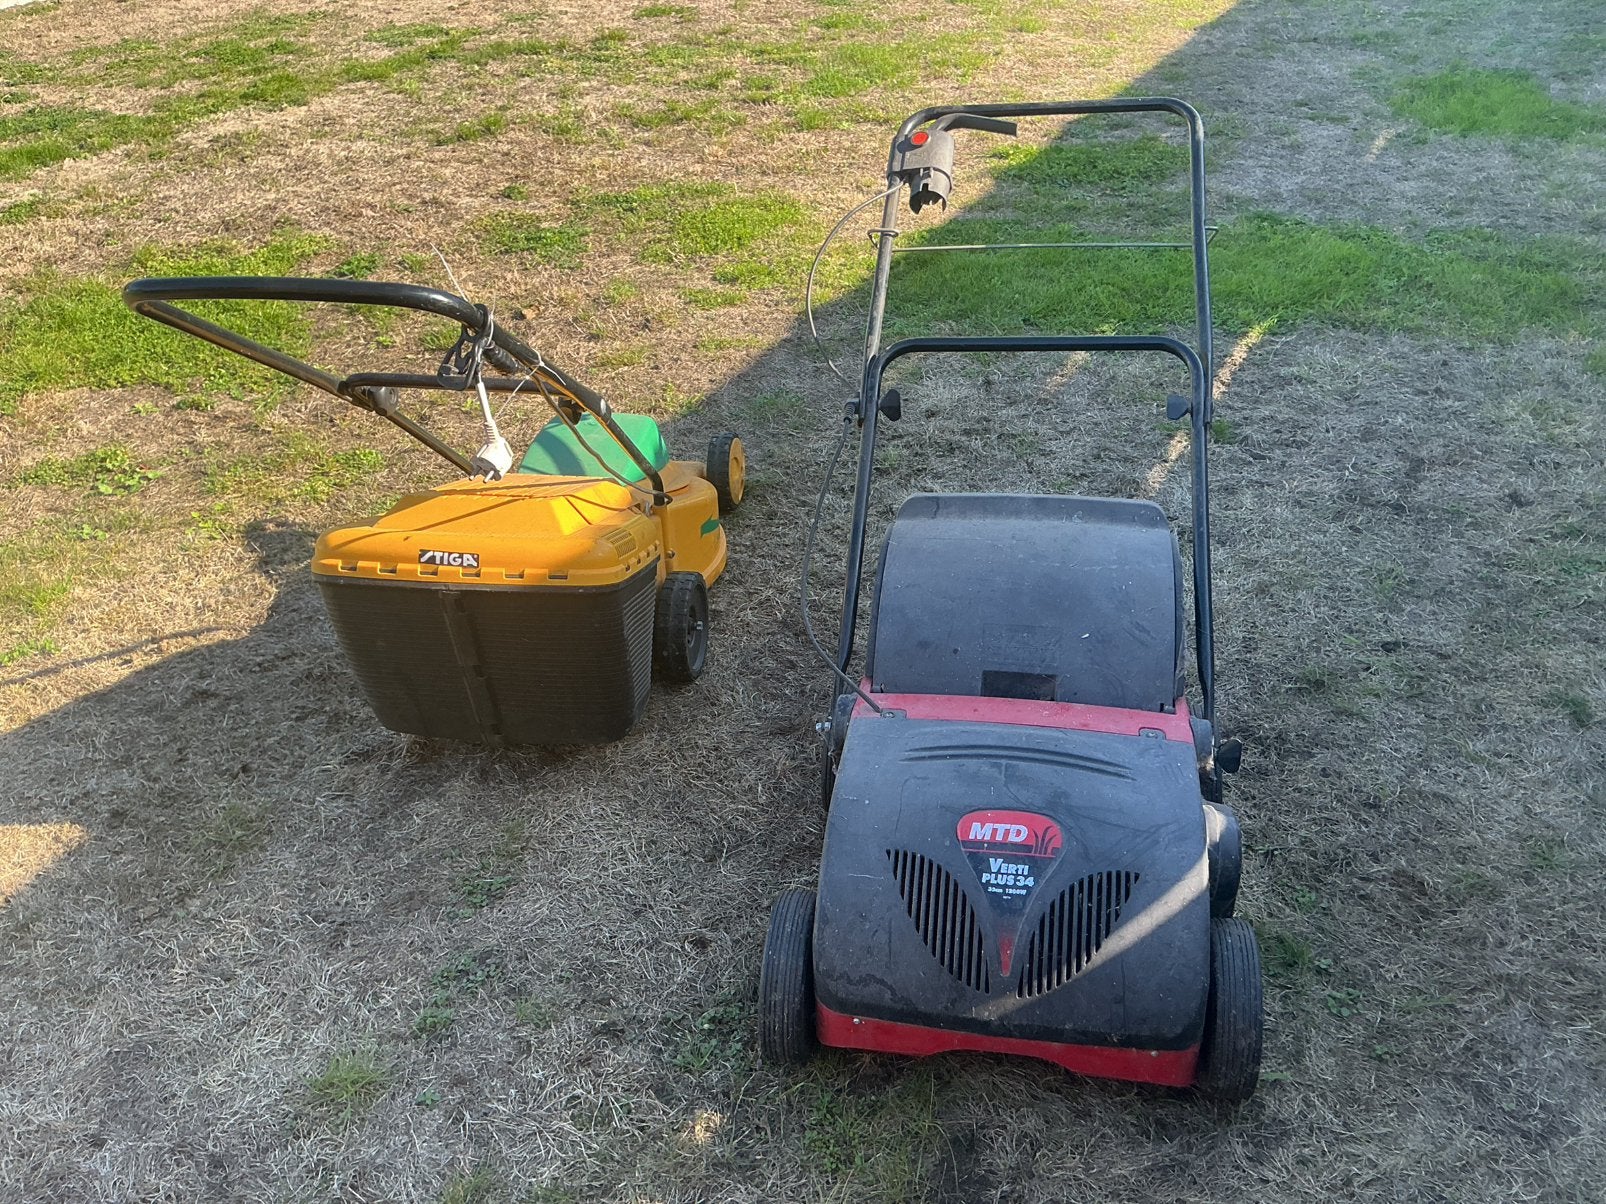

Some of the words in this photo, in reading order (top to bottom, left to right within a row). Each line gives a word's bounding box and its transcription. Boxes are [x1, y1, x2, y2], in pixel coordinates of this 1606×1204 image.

[420, 550, 478, 567] STIGA
[968, 822, 1028, 842] MTD
[989, 858, 1029, 875] VERTI
[981, 873, 1015, 886] PLUS
